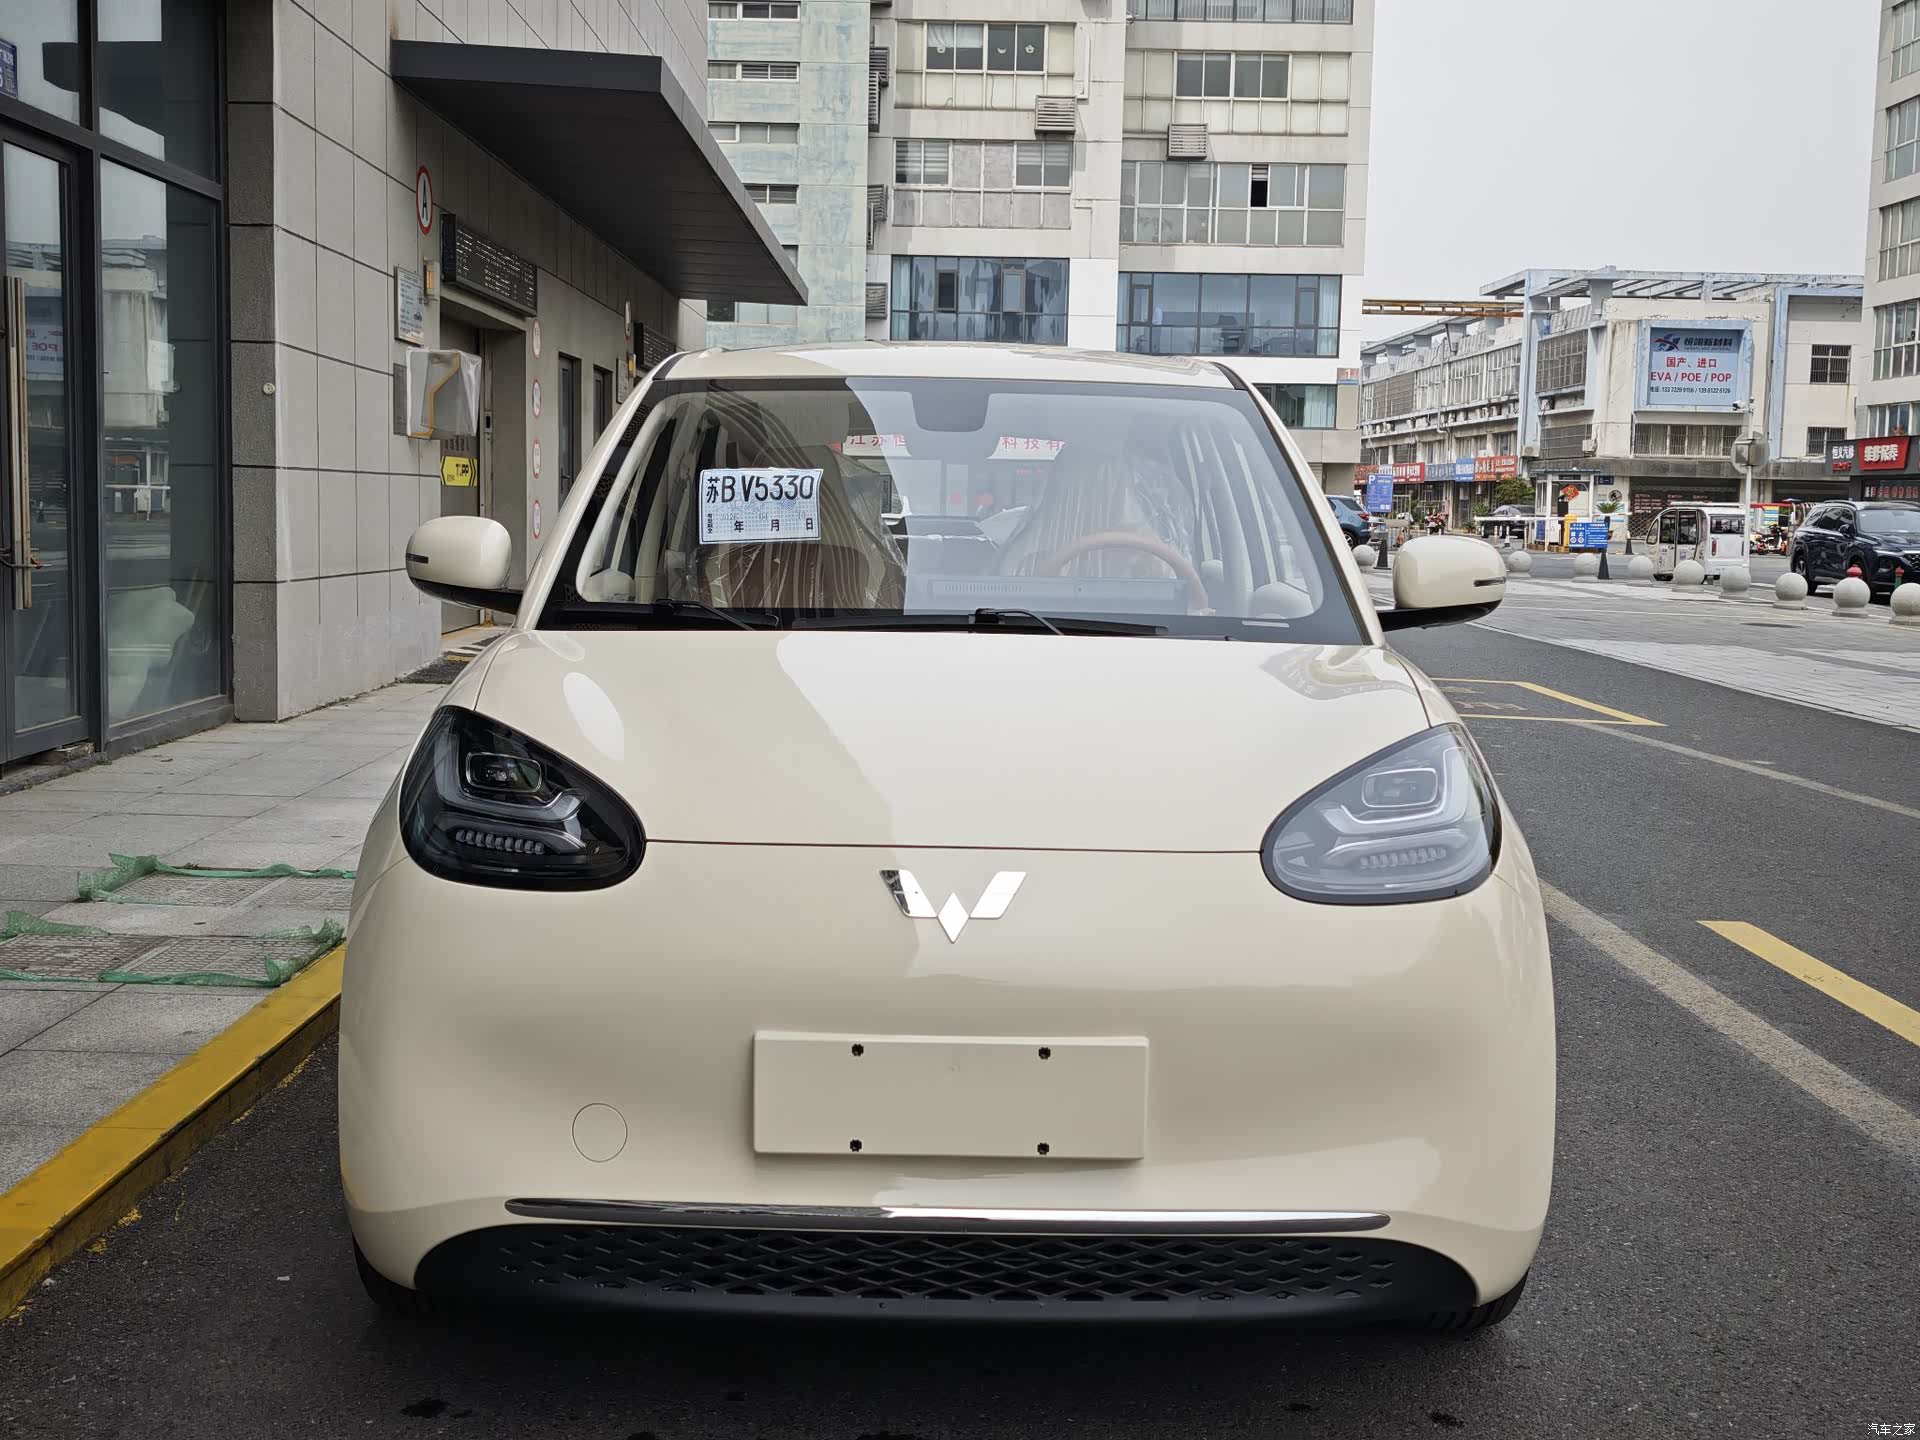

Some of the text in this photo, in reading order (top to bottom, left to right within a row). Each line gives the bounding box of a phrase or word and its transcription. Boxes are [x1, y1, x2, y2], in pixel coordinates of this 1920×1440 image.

[421, 178, 429, 222] A
[1666, 356, 1717, 368] 国产、进口
[1650, 371, 1672, 381] EVA
[1681, 372, 1702, 382] POE
[1711, 373, 1732, 382] POP
[1368, 475, 1376, 485] P
[734, 518, 814, 533] 年 月 日
